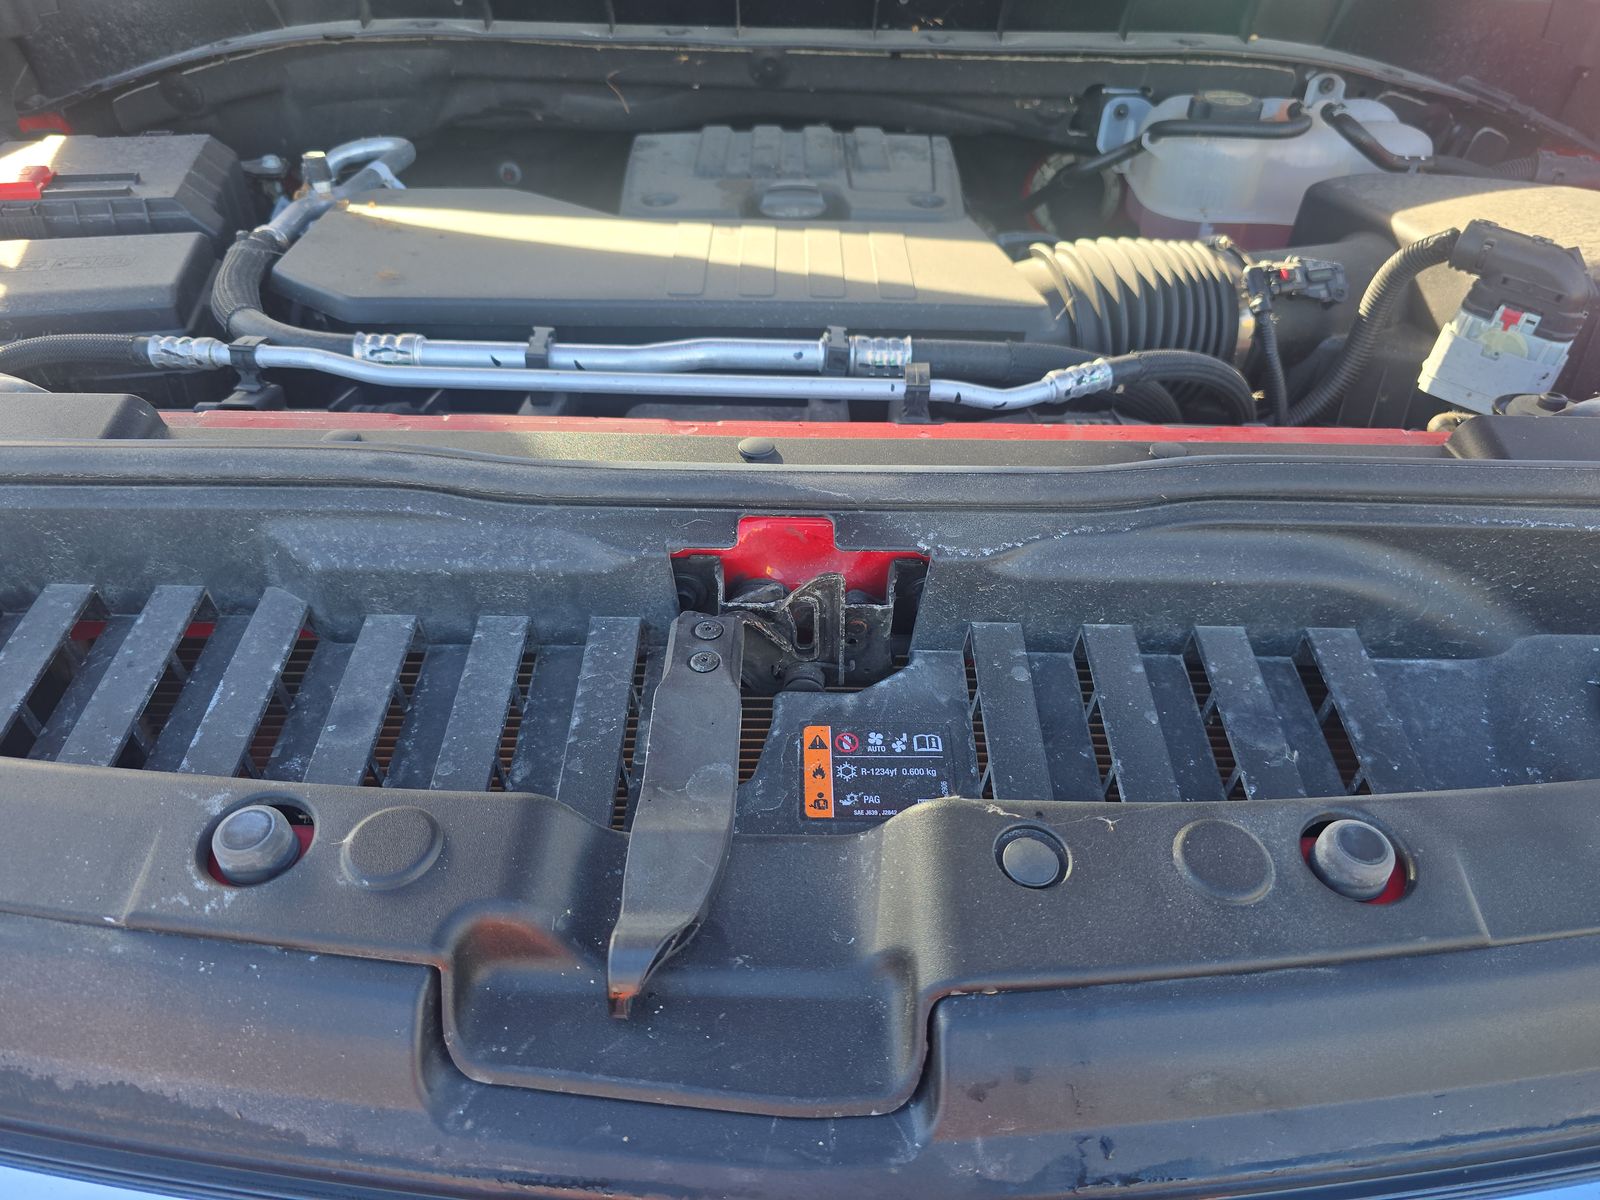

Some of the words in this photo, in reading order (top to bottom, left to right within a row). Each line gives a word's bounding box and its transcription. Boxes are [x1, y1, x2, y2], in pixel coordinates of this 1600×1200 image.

[867, 745, 886, 753] AUTO
[861, 768, 897, 776] R-1234yf
[926, 768, 937, 777] kg
[863, 795, 881, 804] PAG
